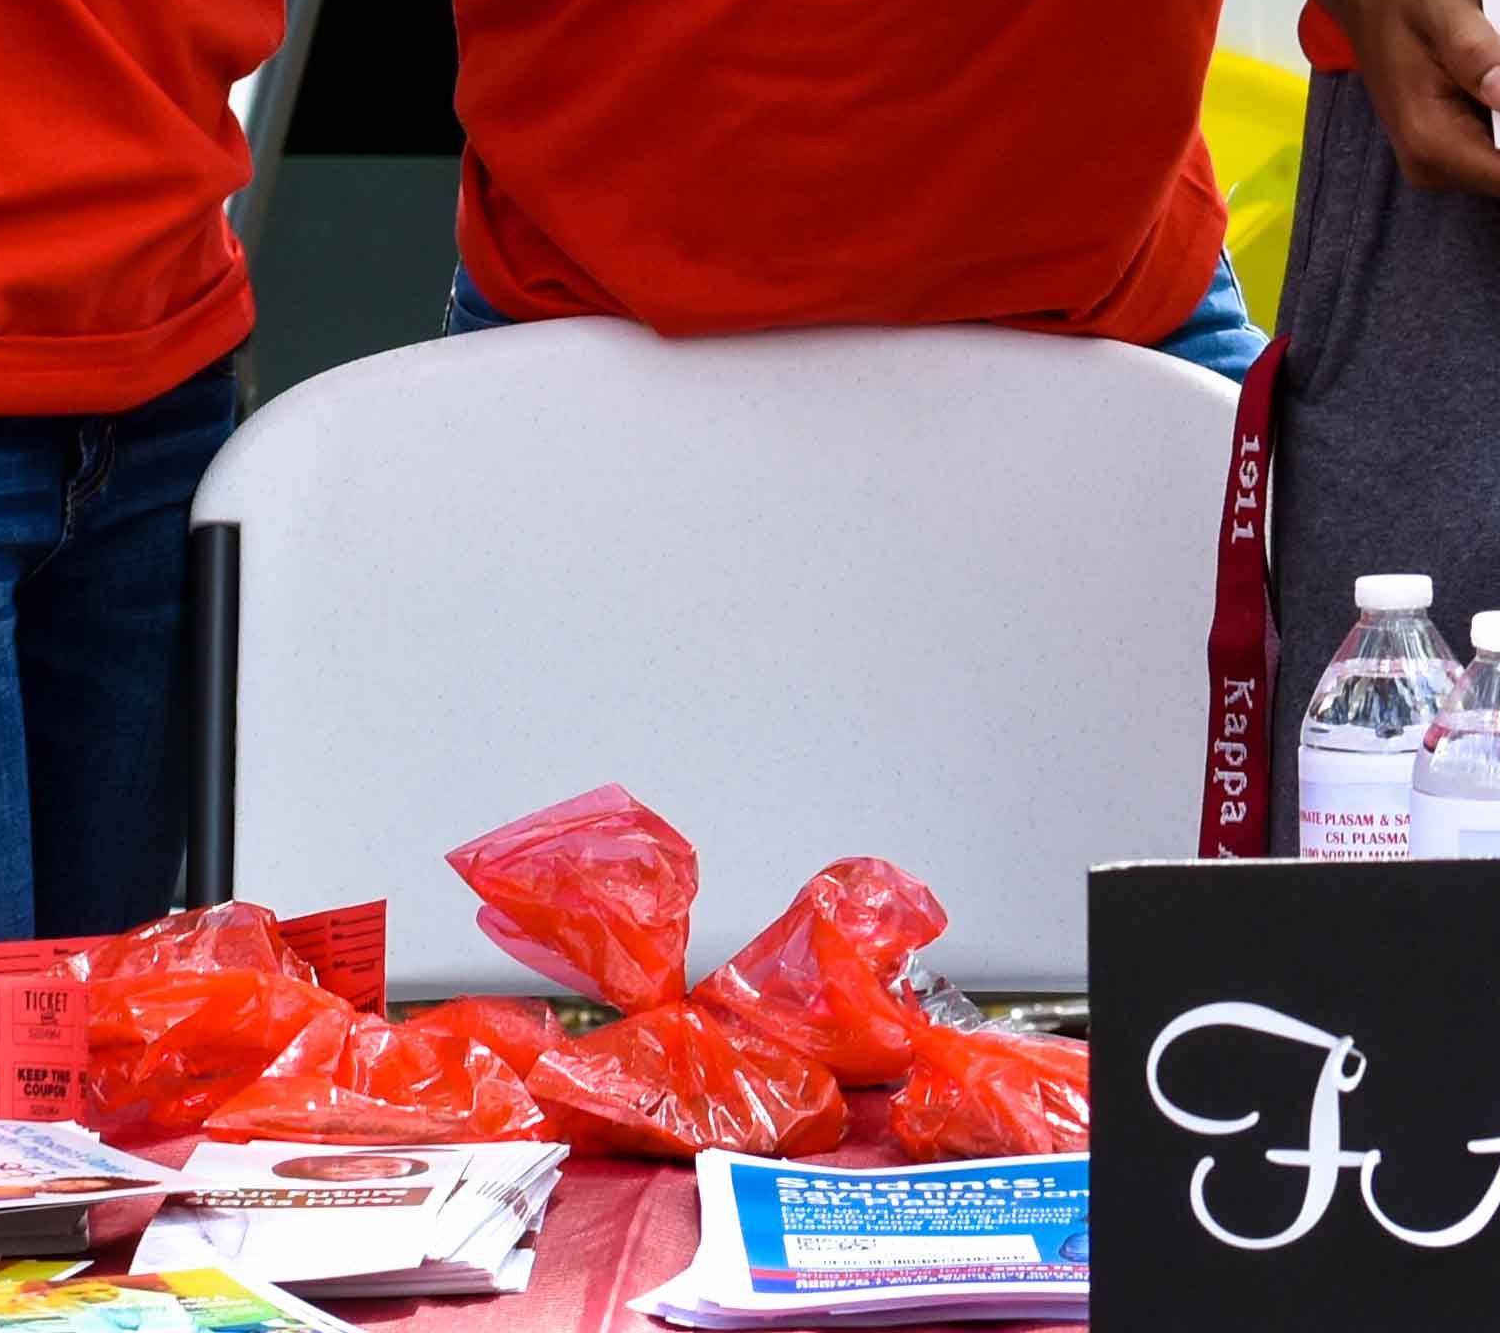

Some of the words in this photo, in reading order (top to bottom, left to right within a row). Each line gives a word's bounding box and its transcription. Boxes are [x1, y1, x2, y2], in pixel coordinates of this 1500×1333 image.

[1231, 434, 1261, 544] 1911
[1214, 677, 1256, 826] Kappa
[1324, 812, 1374, 826] PLASAM
[1380, 814, 1388, 826] &
[1326, 832, 1347, 845] CSL
[1352, 832, 1407, 845] PLASMA
[25, 991, 68, 1012] TICKET
[17, 1069, 49, 1082] KEEP
[52, 1070, 70, 1083] THIS
[24, 1084, 66, 1098] COUPON
[776, 1177, 1056, 1191] Students:
